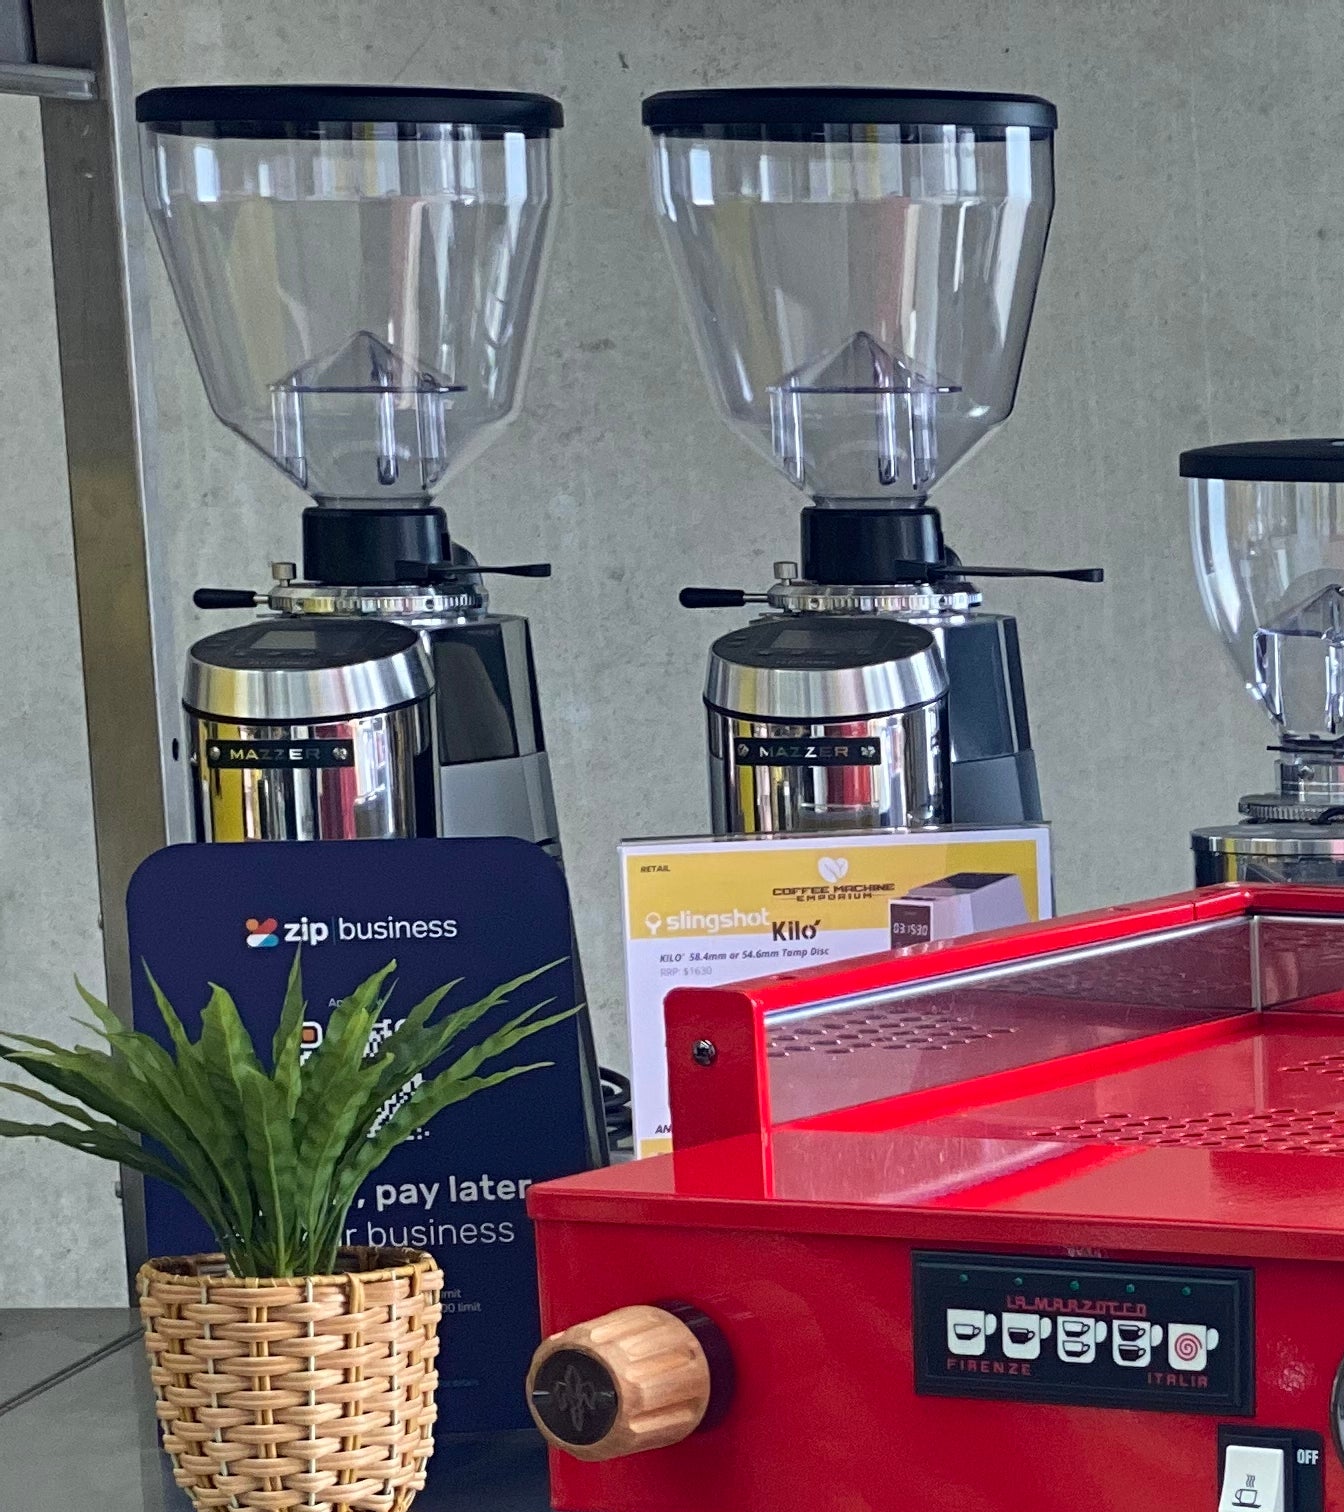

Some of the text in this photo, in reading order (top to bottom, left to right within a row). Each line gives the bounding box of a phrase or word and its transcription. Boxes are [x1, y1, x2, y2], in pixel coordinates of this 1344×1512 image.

[230, 748, 320, 761] MAZZER
[759, 745, 849, 758] MAZZER
[772, 886, 830, 896] COFFEE
[796, 892, 873, 902] EMPORIUM
[666, 906, 770, 933] slingshot
[284, 915, 458, 946] zip business
[375, 1182, 440, 1212] pay
[449, 1173, 532, 1203] later
[367, 1218, 515, 1248] business
[946, 1358, 1031, 1376] FIRENZE
[1147, 1372, 1209, 1388] ITALIA
[1296, 1449, 1319, 1465] OFF
